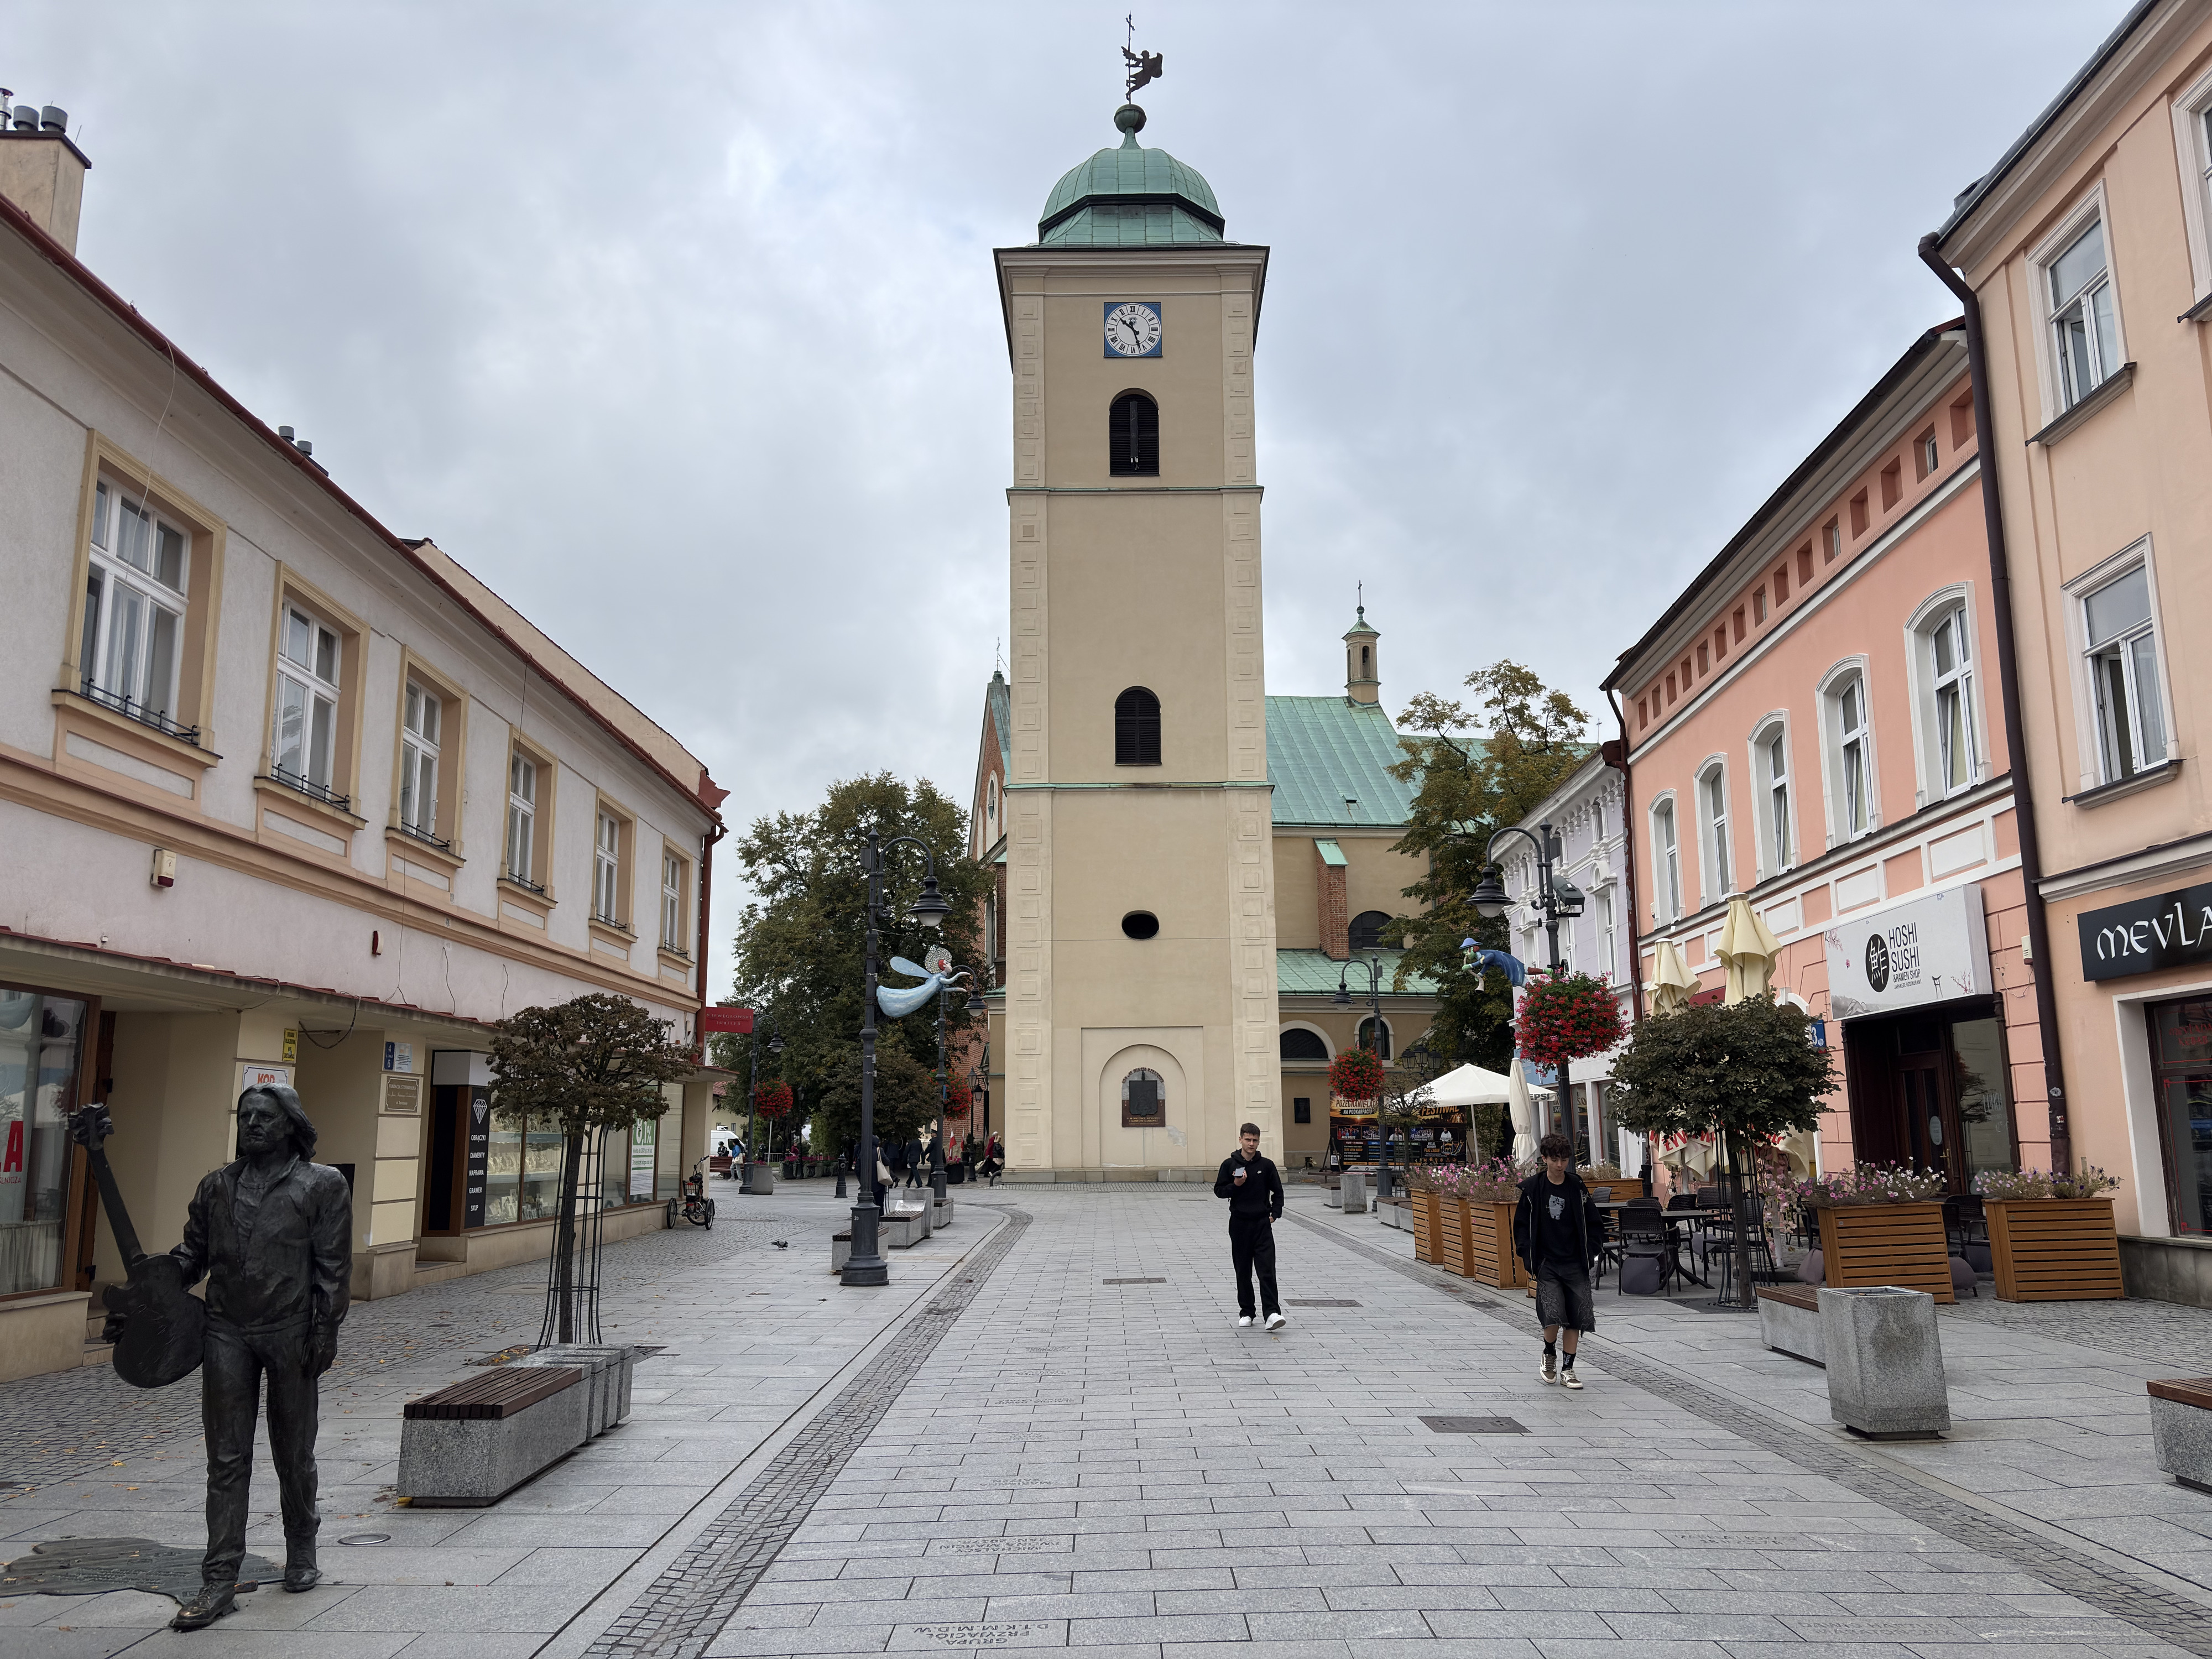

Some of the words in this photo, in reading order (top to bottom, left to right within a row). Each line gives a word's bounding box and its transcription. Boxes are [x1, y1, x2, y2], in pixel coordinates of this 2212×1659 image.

[1888, 922, 1917, 950] HOSHI
[1891, 946, 1920, 973] SUSHI
[1893, 972, 1910, 983] &RAMEN
[1910, 969, 1921, 979] SHOP
[387, 1059, 390, 1068] 6
[471, 1134, 486, 1142] OBRĄCZKI
